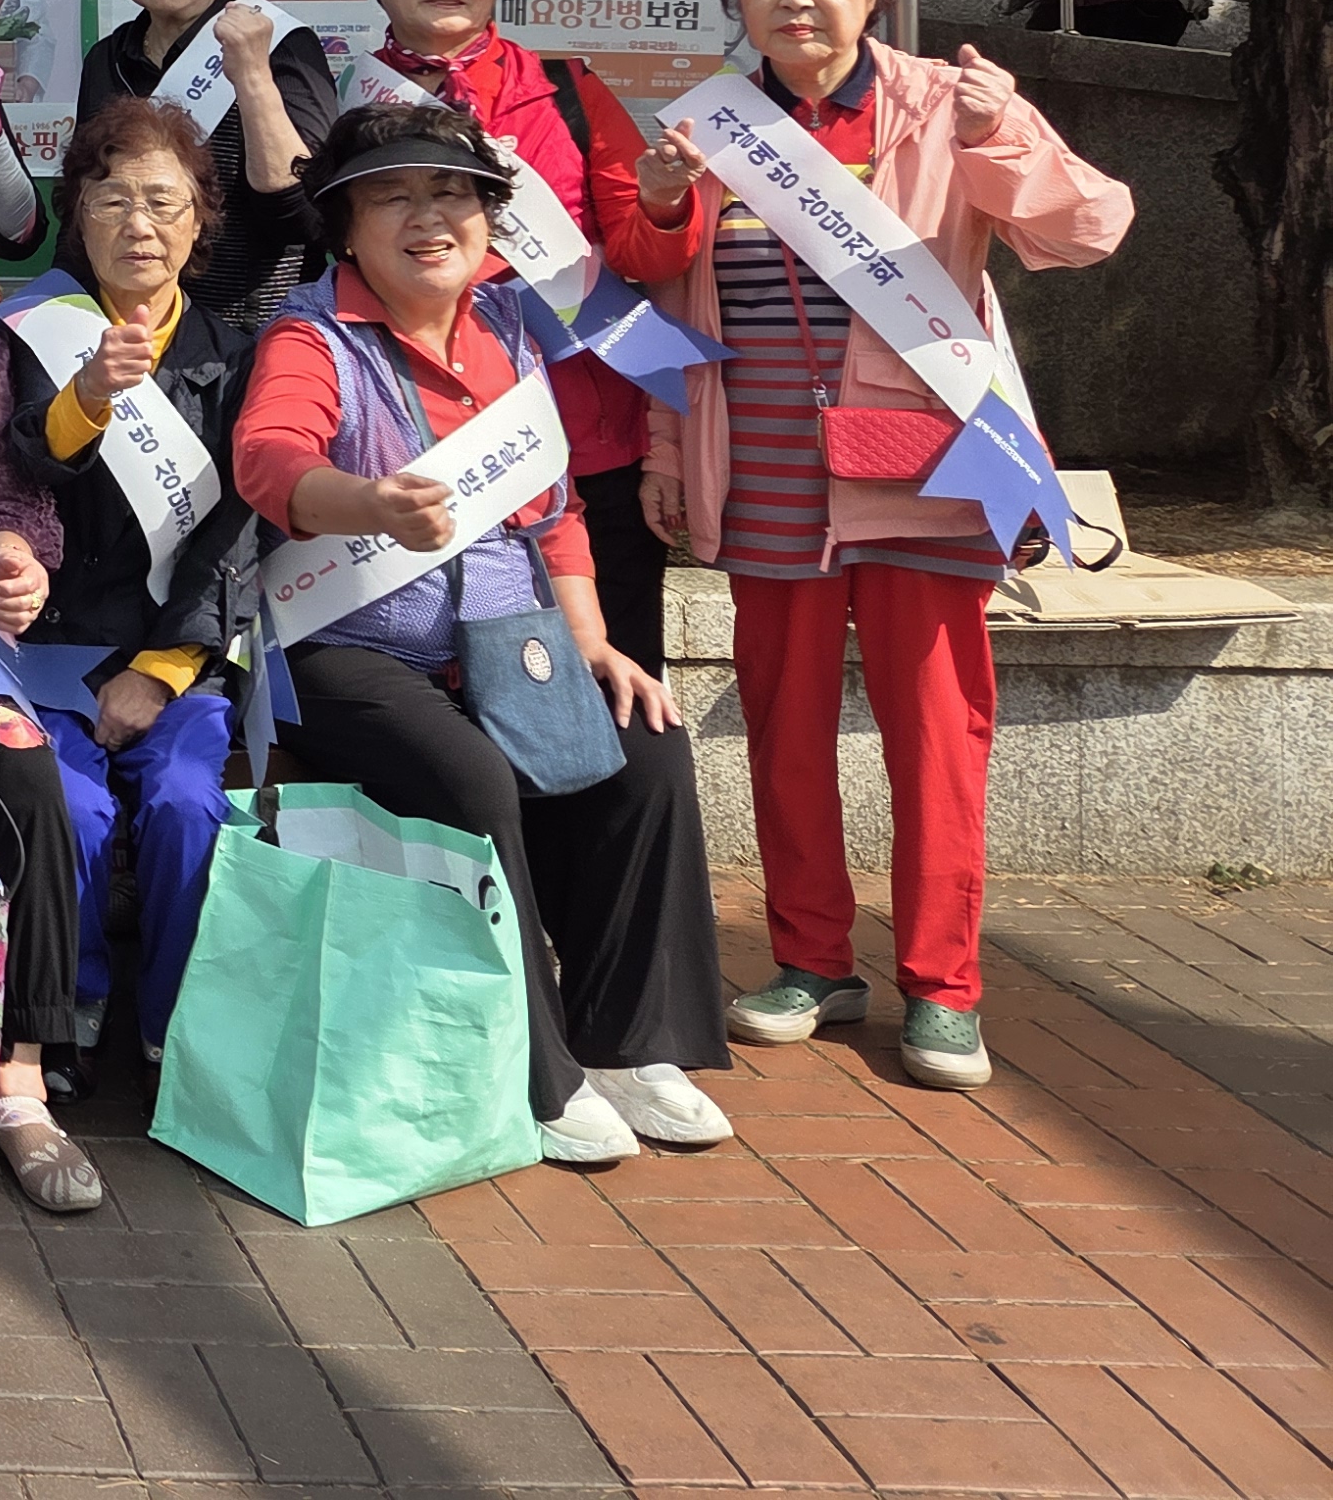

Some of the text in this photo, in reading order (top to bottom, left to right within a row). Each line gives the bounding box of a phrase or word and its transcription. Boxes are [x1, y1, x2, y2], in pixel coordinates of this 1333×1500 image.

[186, 54, 224, 101] 예방
[707, 105, 972, 366] 자살예방 상담전화 109
[154, 458, 198, 536] 상담전
[456, 424, 543, 498] 자살예방
[275, 558, 338, 604] 109
